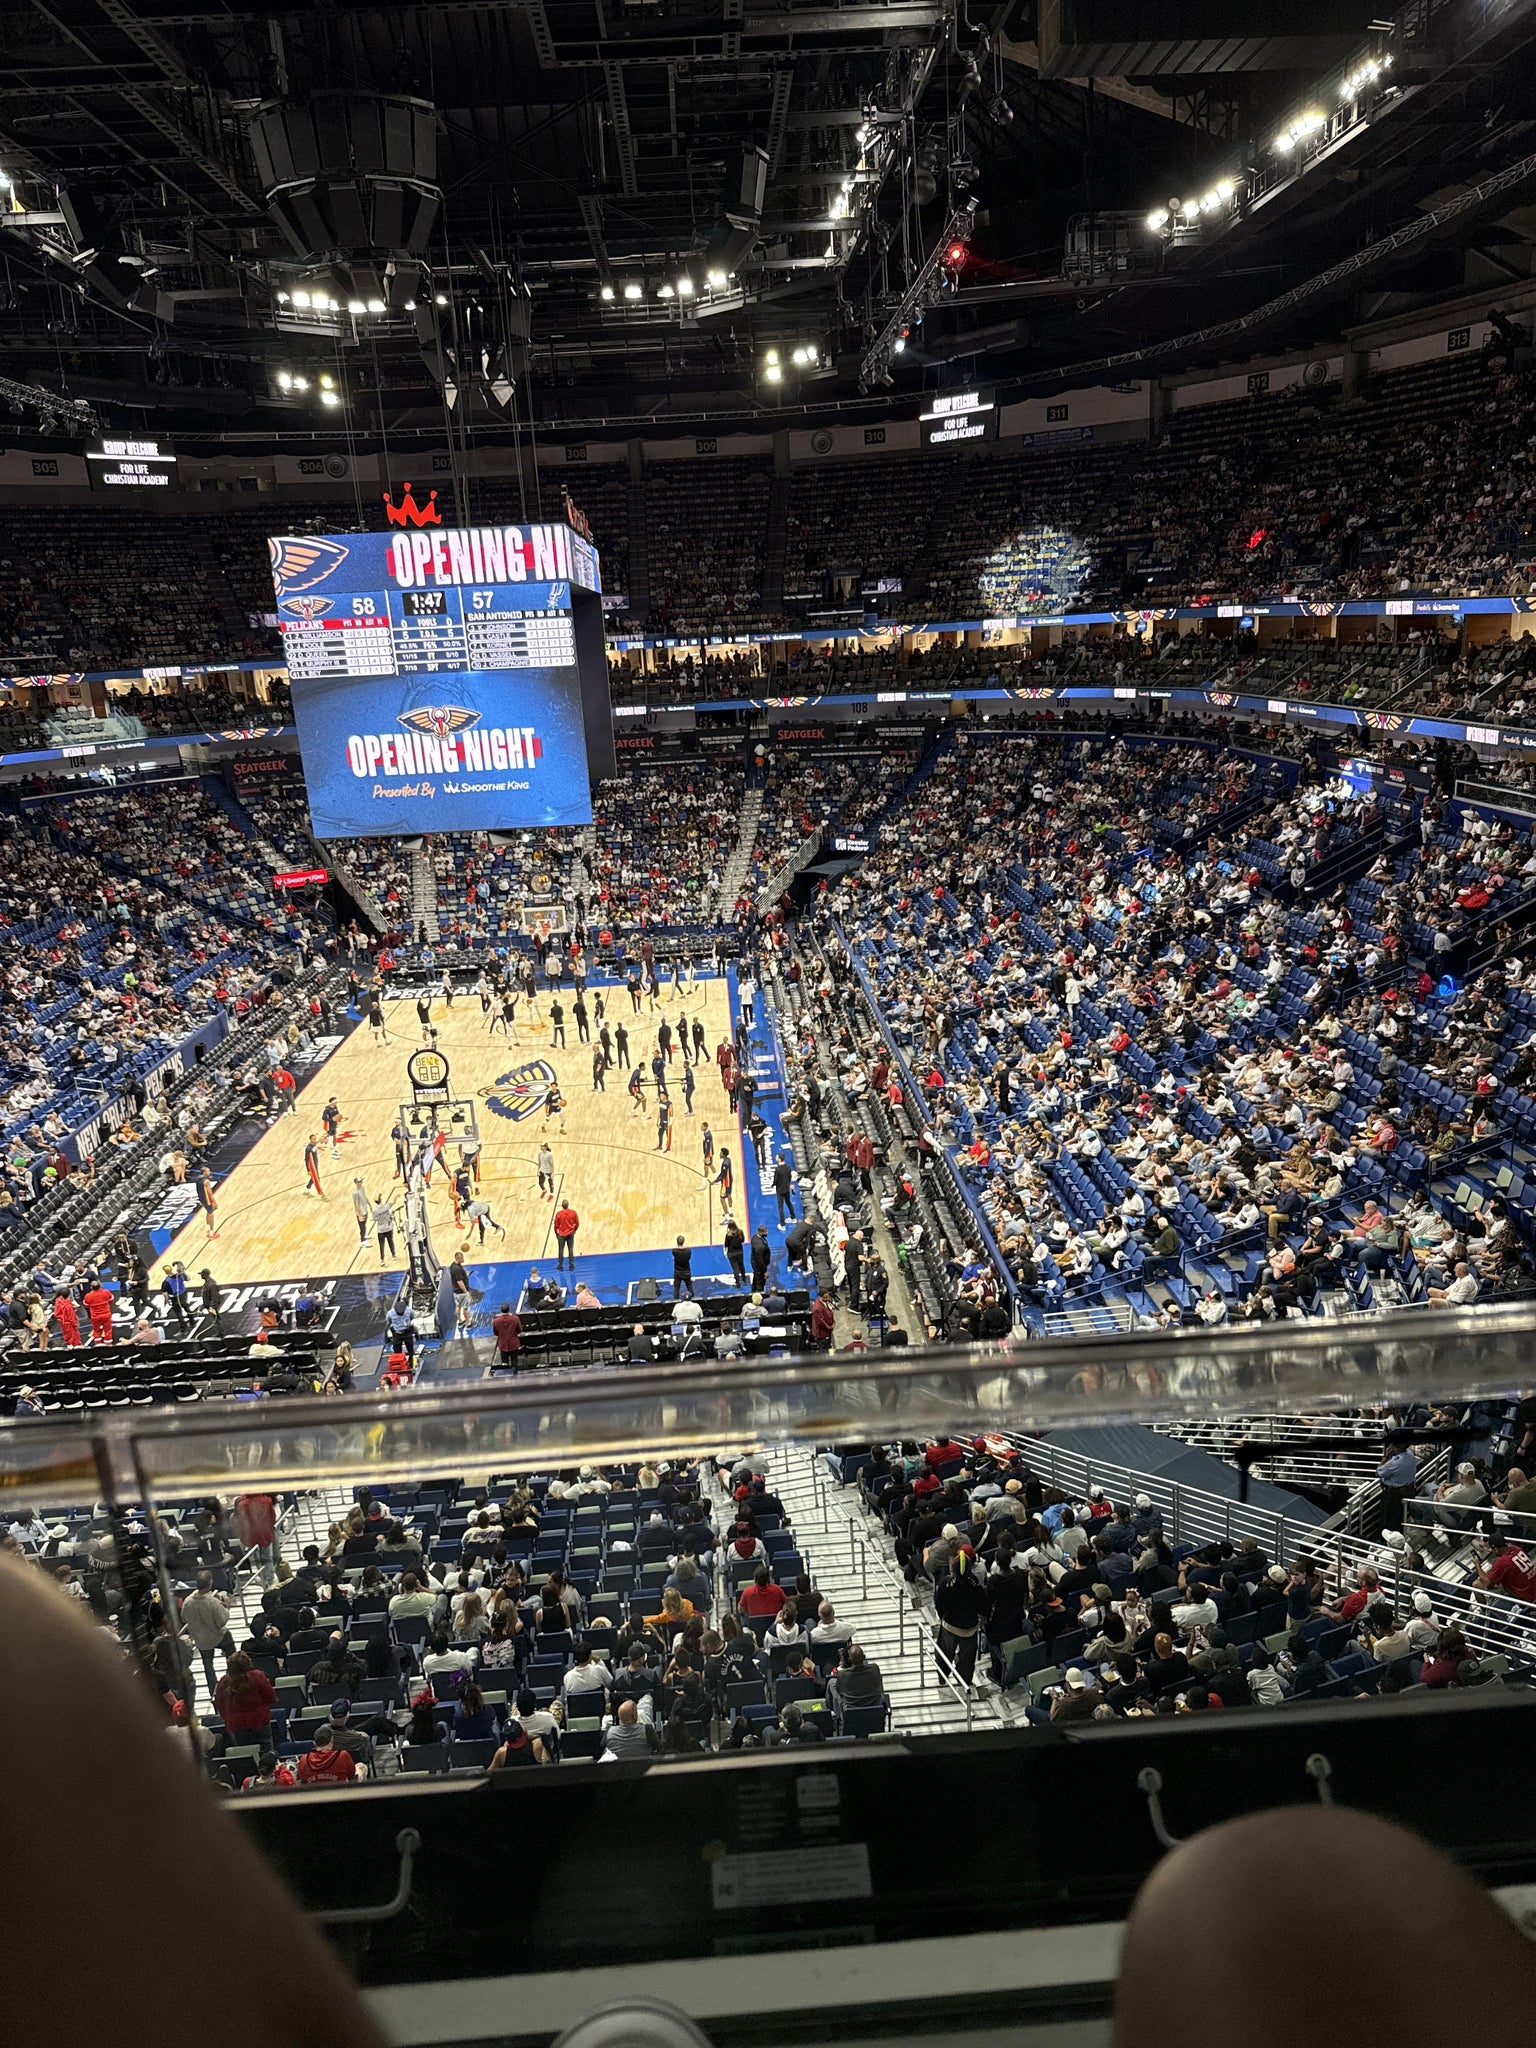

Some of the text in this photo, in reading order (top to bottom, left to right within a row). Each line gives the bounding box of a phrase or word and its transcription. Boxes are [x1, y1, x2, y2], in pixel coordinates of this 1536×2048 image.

[1449, 332, 1468, 348] 313
[1250, 375, 1268, 389] 312
[952, 392, 980, 410] WELCOME
[1049, 408, 1066, 420] 311
[944, 416, 968, 430] FOR LIFE
[866, 432, 884, 442] 310
[930, 424, 984, 444] CHRISTIAN ACADEMY
[103, 440, 160, 456] GROUP WELCOME
[696, 442, 716, 452] 309
[566, 450, 586, 459] 308
[33, 462, 56, 474] 305
[120, 464, 149, 474] FOR LIFE
[301, 462, 323, 473] 306
[103, 474, 169, 486] CHRISTIAN ACADEMY
[392, 526, 527, 588] OPENING
[352, 597, 375, 616] 58
[410, 592, 443, 608] 1:47
[472, 591, 494, 609] 57
[401, 617, 452, 628] 0 FOULS 0
[468, 612, 485, 621] SAN
[486, 610, 522, 620] ANTONIO
[286, 619, 324, 631] PELICANS
[402, 631, 409, 640] 5
[448, 629, 454, 637] 5
[852, 702, 868, 714] 108
[778, 728, 825, 740] SEATGEEK
[348, 727, 536, 778] OPENING NIGHT
[70, 754, 86, 768] 104
[233, 759, 288, 776] SEATGEEK
[372, 781, 529, 799] Presented By SMOOTHIE KING
[76, 1116, 102, 1161] NEW
[138, 1198, 186, 1231] BART
[414, 1257, 424, 1284] NBA
[732, 1665, 742, 1679] 1
